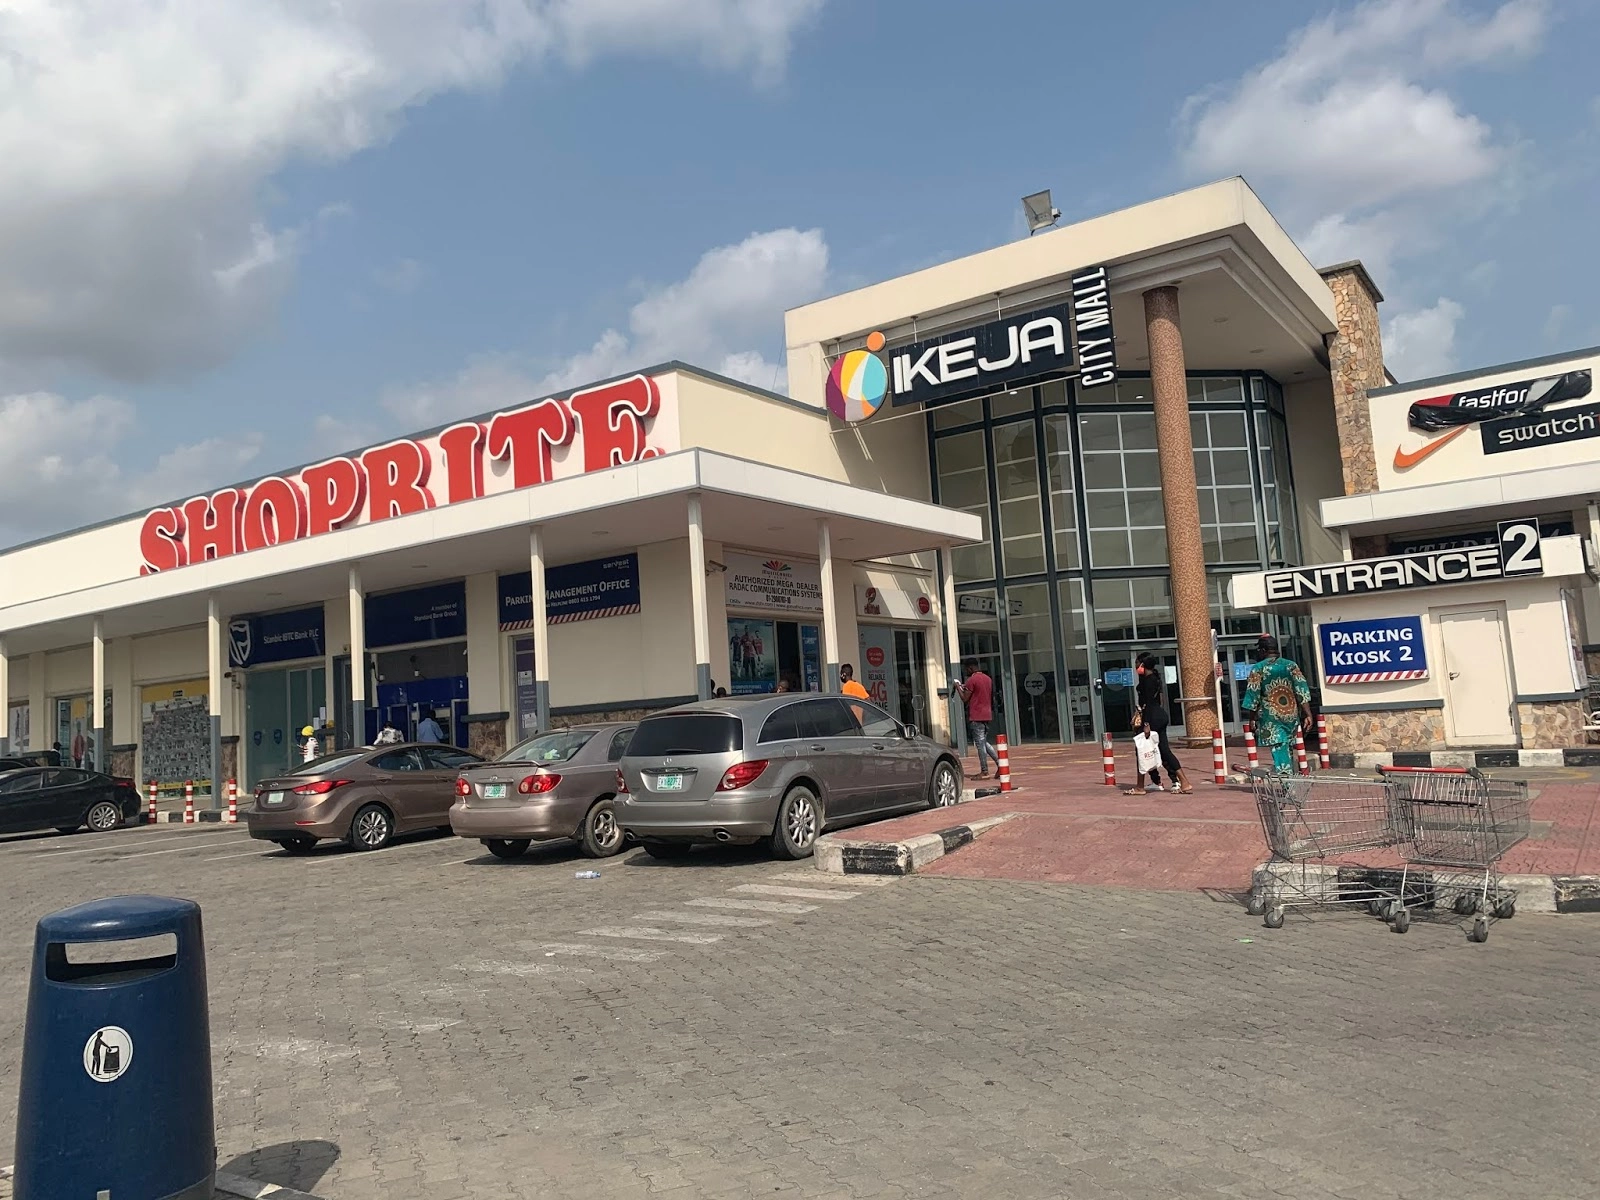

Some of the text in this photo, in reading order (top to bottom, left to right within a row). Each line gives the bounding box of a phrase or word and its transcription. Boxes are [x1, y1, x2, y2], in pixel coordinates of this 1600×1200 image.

[1072, 267, 1114, 386] CITY MALL
[893, 316, 1065, 394] IKEJA
[1498, 413, 1595, 444] swatch
[140, 374, 664, 576] SHOPRITE
[1266, 523, 1542, 600] ENTRANCE 2
[505, 579, 631, 607] PARKIN MANAGEMENT OFFICE
[728, 582, 749, 592] RADAC
[749, 584, 800, 597] COMMUNICATIONS
[734, 574, 819, 591] AUTHORIZED MEGA DEALER
[294, 630, 309, 640] Bank
[308, 628, 320, 638] PLC
[1329, 627, 1414, 646] PARKING
[1331, 646, 1414, 667] KIOSK 2
[868, 673, 886, 681] RELIABLE
[870, 681, 888, 702] 4G
